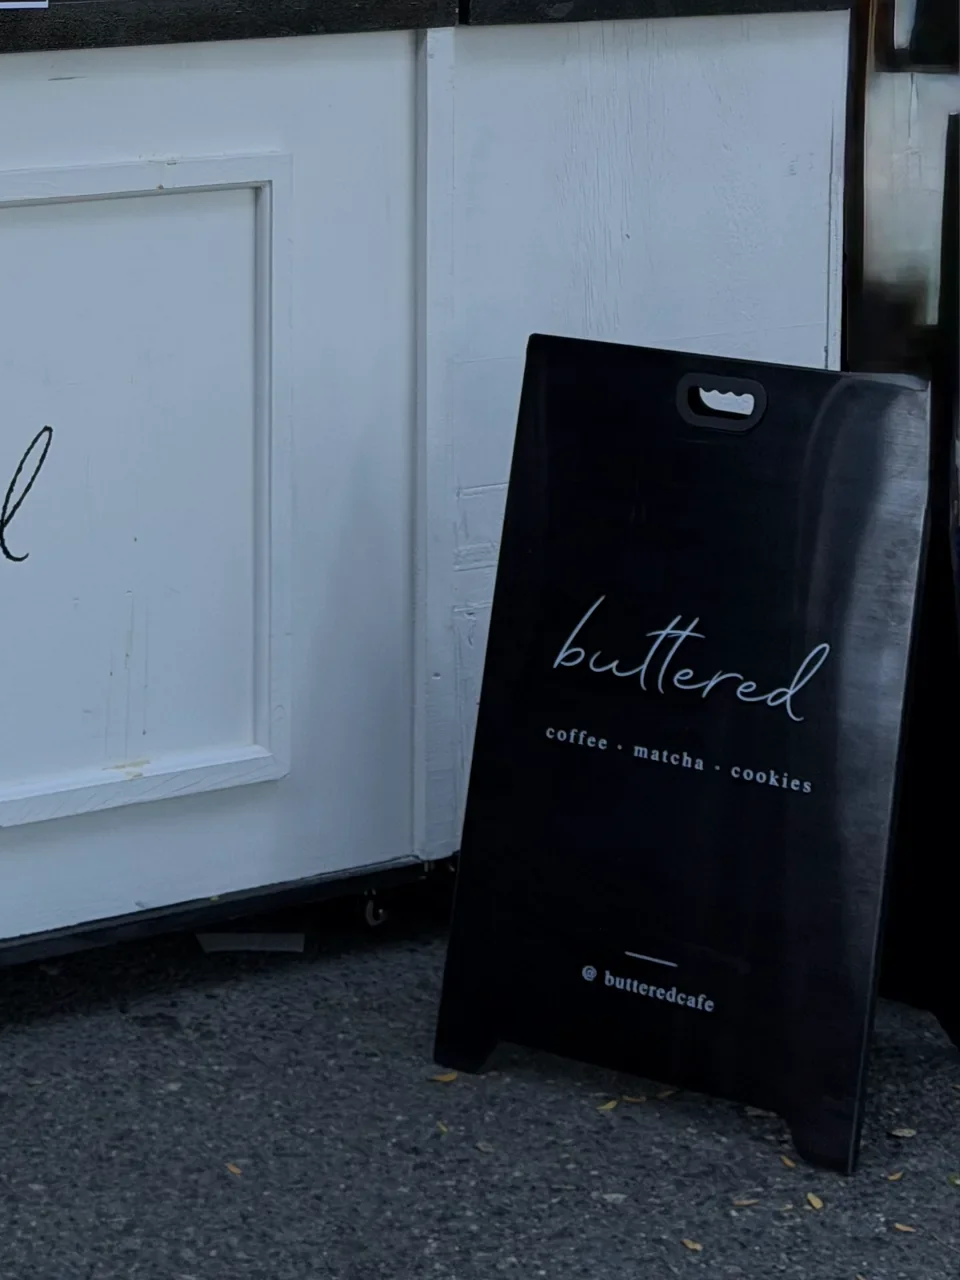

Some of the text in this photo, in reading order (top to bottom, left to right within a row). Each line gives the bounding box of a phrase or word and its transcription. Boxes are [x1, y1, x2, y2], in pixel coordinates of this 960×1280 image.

[552, 594, 830, 722] buttered
[545, 725, 812, 794] coffee matcha cookies
[604, 969, 715, 1013] butteredcafe
